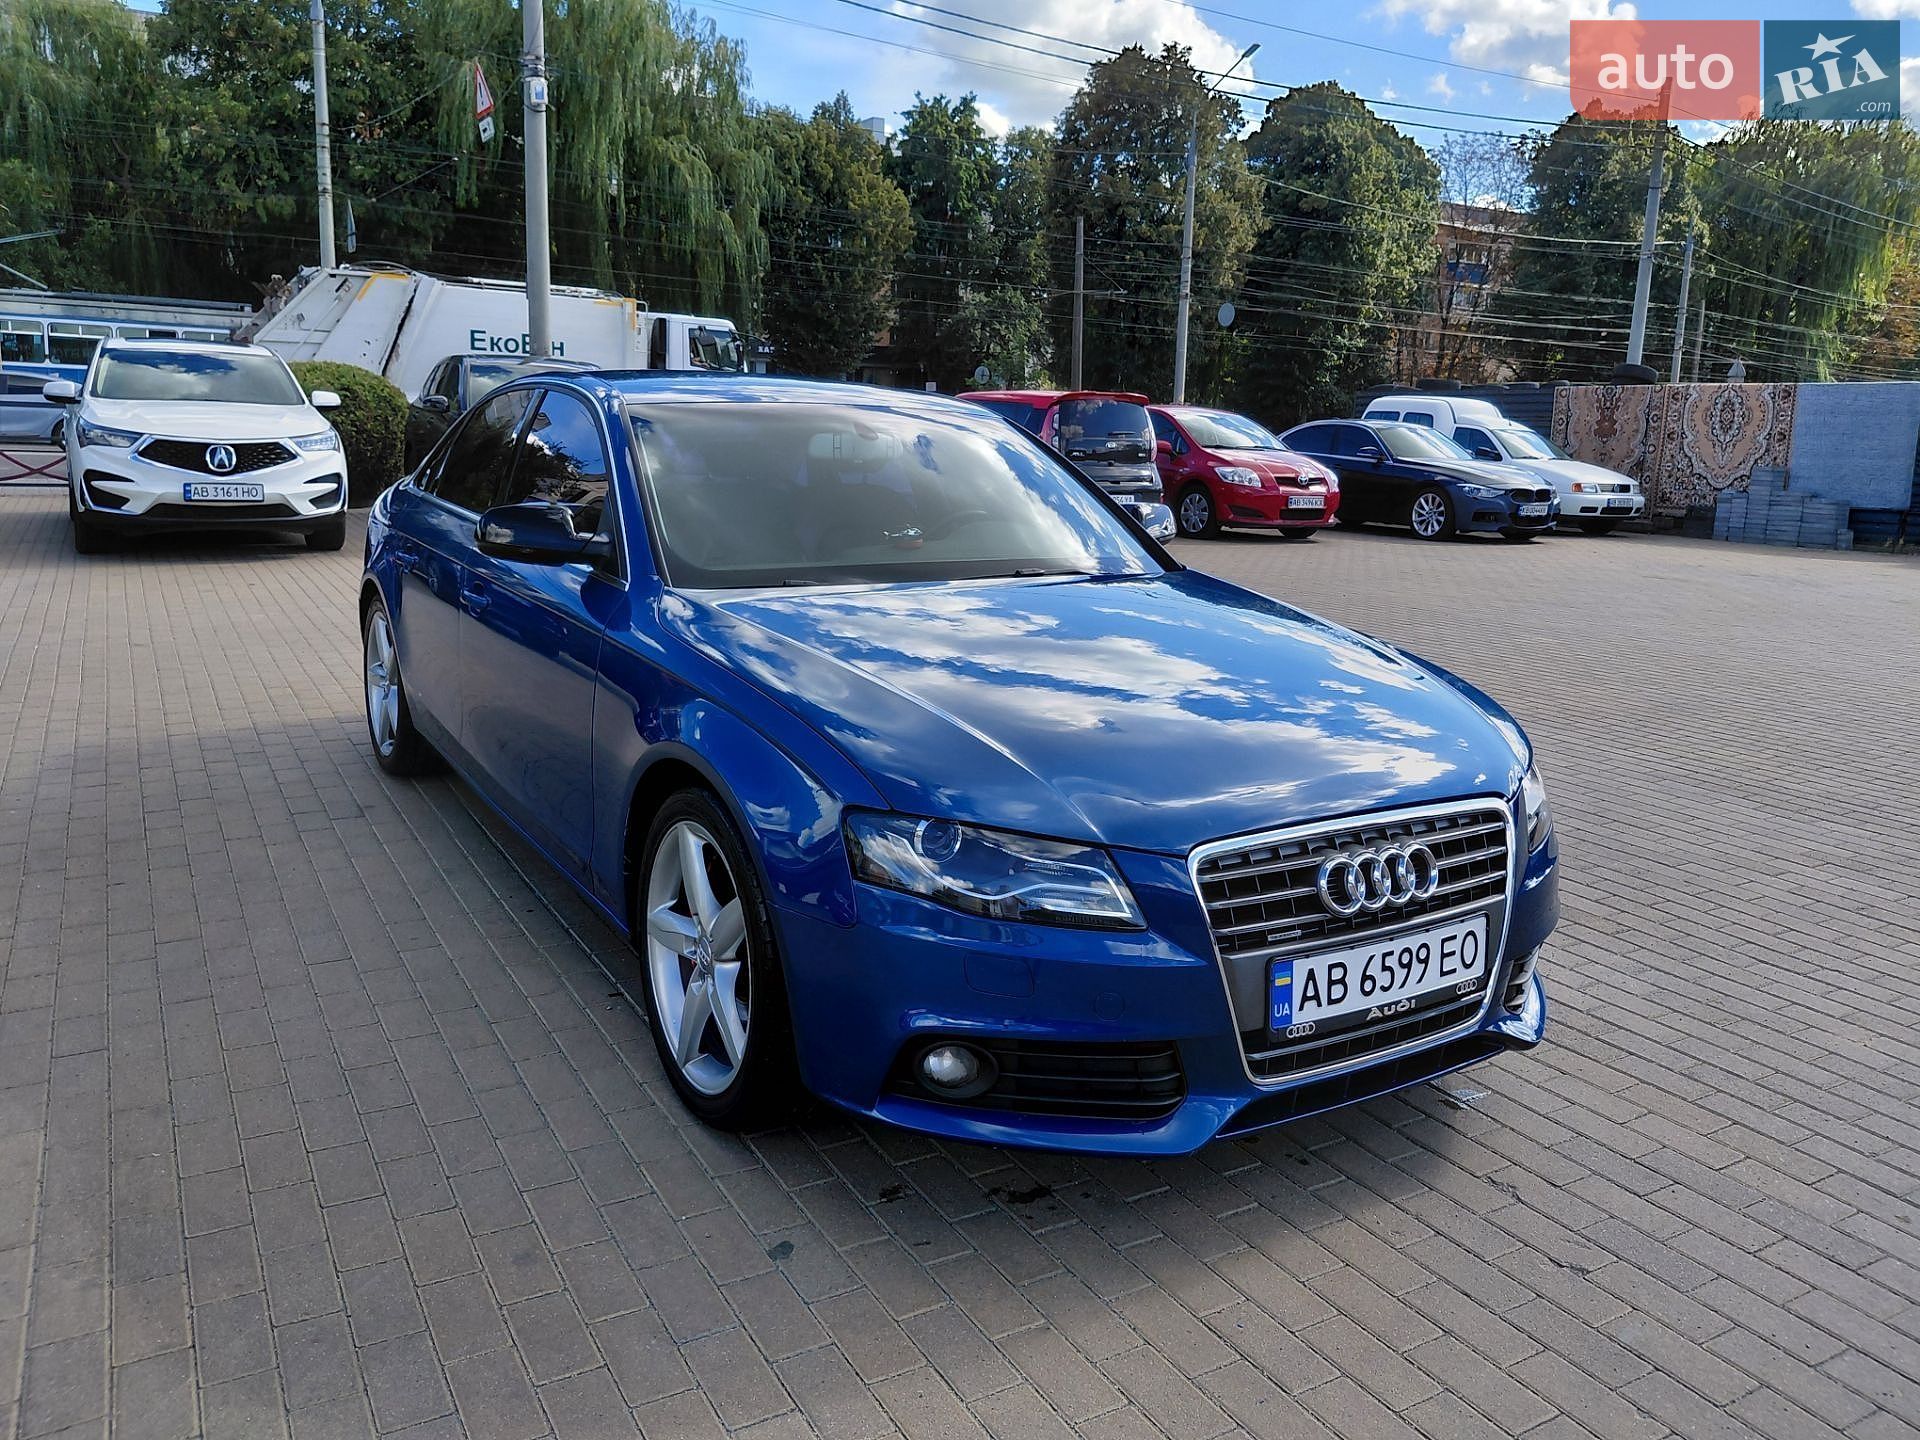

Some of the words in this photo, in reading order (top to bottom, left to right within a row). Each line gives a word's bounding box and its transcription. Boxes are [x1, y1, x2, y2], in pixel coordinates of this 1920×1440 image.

[469, 329, 565, 357] ЕкоВн
[192, 486, 209, 498] AB
[212, 486, 239, 498] 3161
[241, 487, 259, 498] HO
[1297, 960, 1350, 1013] AB
[1358, 942, 1432, 998] 6599
[1438, 929, 1479, 979] EO
[1273, 1003, 1291, 1019] UA
